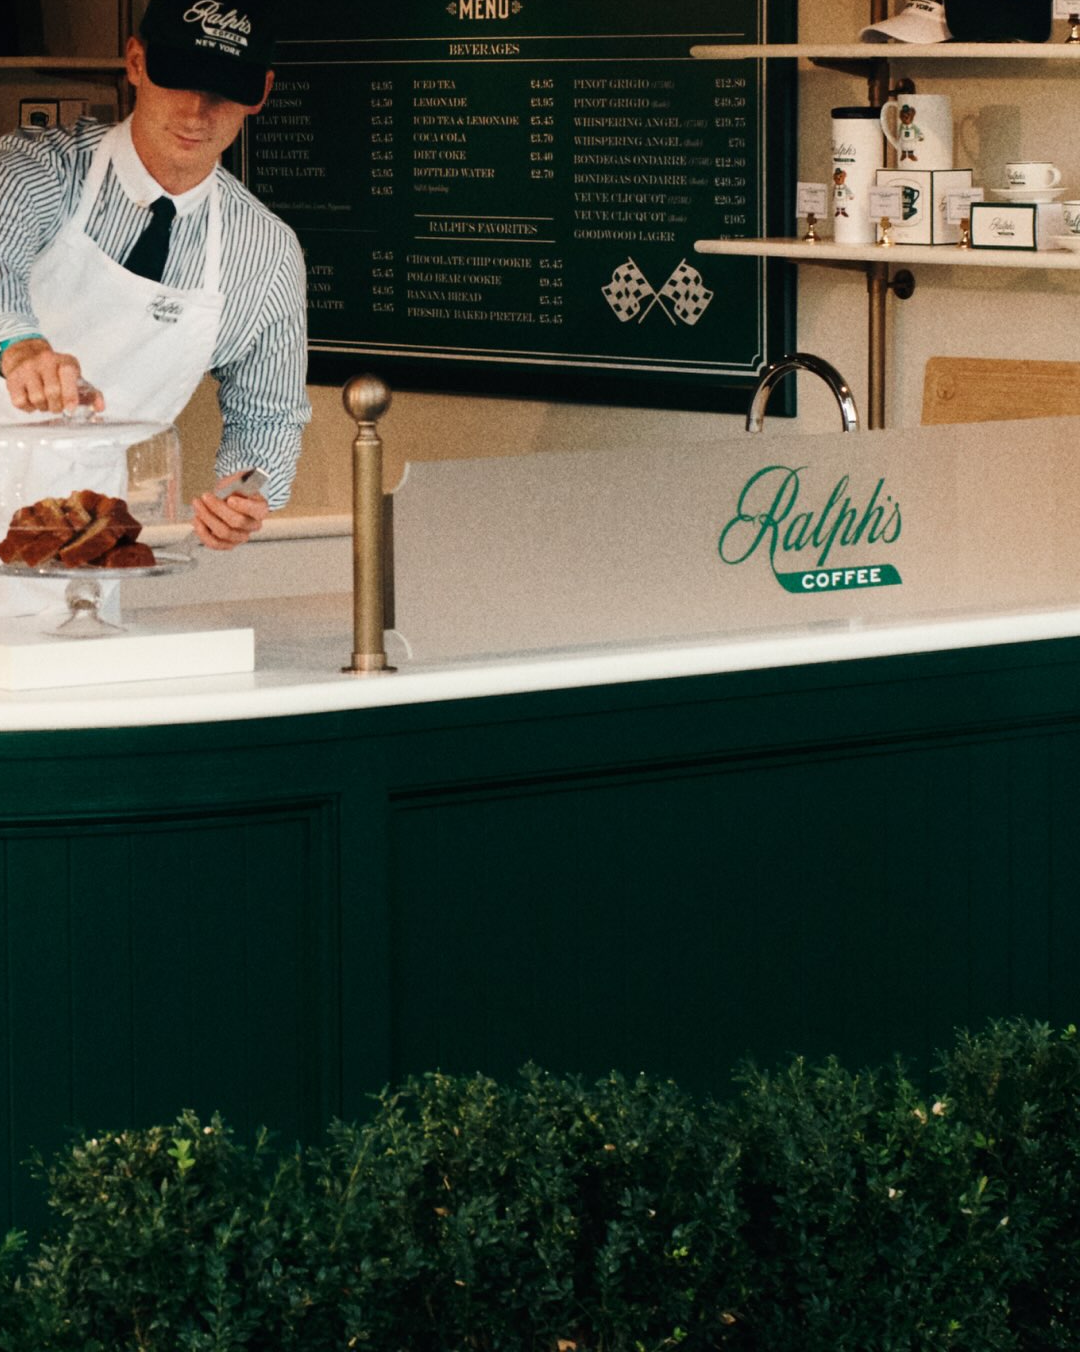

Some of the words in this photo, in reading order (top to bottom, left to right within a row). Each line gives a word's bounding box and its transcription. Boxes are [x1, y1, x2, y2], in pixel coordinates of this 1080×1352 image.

[195, 38, 217, 48] NEW
[219, 43, 241, 57] YORK
[448, 43, 520, 56] BEVERAGES
[413, 79, 436, 89] ICED
[437, 79, 456, 89] TEA
[529, 79, 554, 89] £4.95
[573, 78, 607, 89] PINOT
[608, 78, 650, 89] GRIGIO
[714, 77, 746, 88] £12.80
[413, 97, 468, 108] LEMONADE
[529, 97, 554, 108] £3.95
[573, 97, 607, 108] PINOT
[608, 97, 650, 108] GRIGIO
[255, 115, 280, 125] FLAT
[280, 115, 311, 125] WHITE
[413, 115, 436, 126] ICED
[437, 115, 455, 126] TEA
[466, 115, 520, 126] LEMONADE
[529, 115, 554, 126] £5.45
[573, 116, 642, 128] WHISPERING
[644, 116, 682, 128] ANGEL
[714, 116, 746, 128] £19.75
[255, 132, 314, 142] CAPPUCCINO
[413, 133, 438, 143] COCA
[440, 133, 467, 143] COLA
[573, 135, 642, 147] WHISPERING
[644, 135, 682, 147] ANGEL
[280, 150, 310, 160] LATTE
[413, 150, 437, 160] DIET
[438, 150, 467, 160] COKE
[573, 154, 632, 165] BONDEGAS
[633, 155, 687, 165] ONDARRE
[255, 166, 295, 177] MATCHA
[295, 167, 326, 177] LATTE
[413, 167, 459, 178] BOTTLED
[460, 168, 495, 178] WATER
[529, 168, 554, 179] £2.70
[573, 173, 632, 184] BONDEGAS
[633, 174, 687, 185] ONDARRE
[256, 183, 274, 193] TEA
[574, 192, 610, 203] VEUVE
[611, 193, 666, 204] CLICQUOT
[574, 210, 610, 221] VEUVE
[611, 210, 666, 222] CLICQUOT
[428, 221, 476, 233] RALPH'S
[477, 222, 538, 234] FAVORITES
[573, 230, 637, 241] GOODWOOD
[638, 230, 675, 242] LAGER
[406, 254, 465, 266] CHOCOLATE
[466, 256, 491, 267] CHIP
[492, 256, 532, 268] COOKIE
[538, 258, 563, 269] £5.45
[407, 272, 433, 282] POLO
[434, 273, 461, 284] BEAR
[462, 274, 502, 285] COOKIE
[407, 289, 446, 301] BANANA
[447, 291, 482, 302] BREAD
[316, 299, 345, 310] LATTE
[407, 307, 450, 319] FRESHLY
[454, 309, 488, 321] BAKED
[489, 311, 536, 323] PRETZEL
[718, 465, 902, 574] Ralph's
[801, 568, 882, 589] COFFEE
